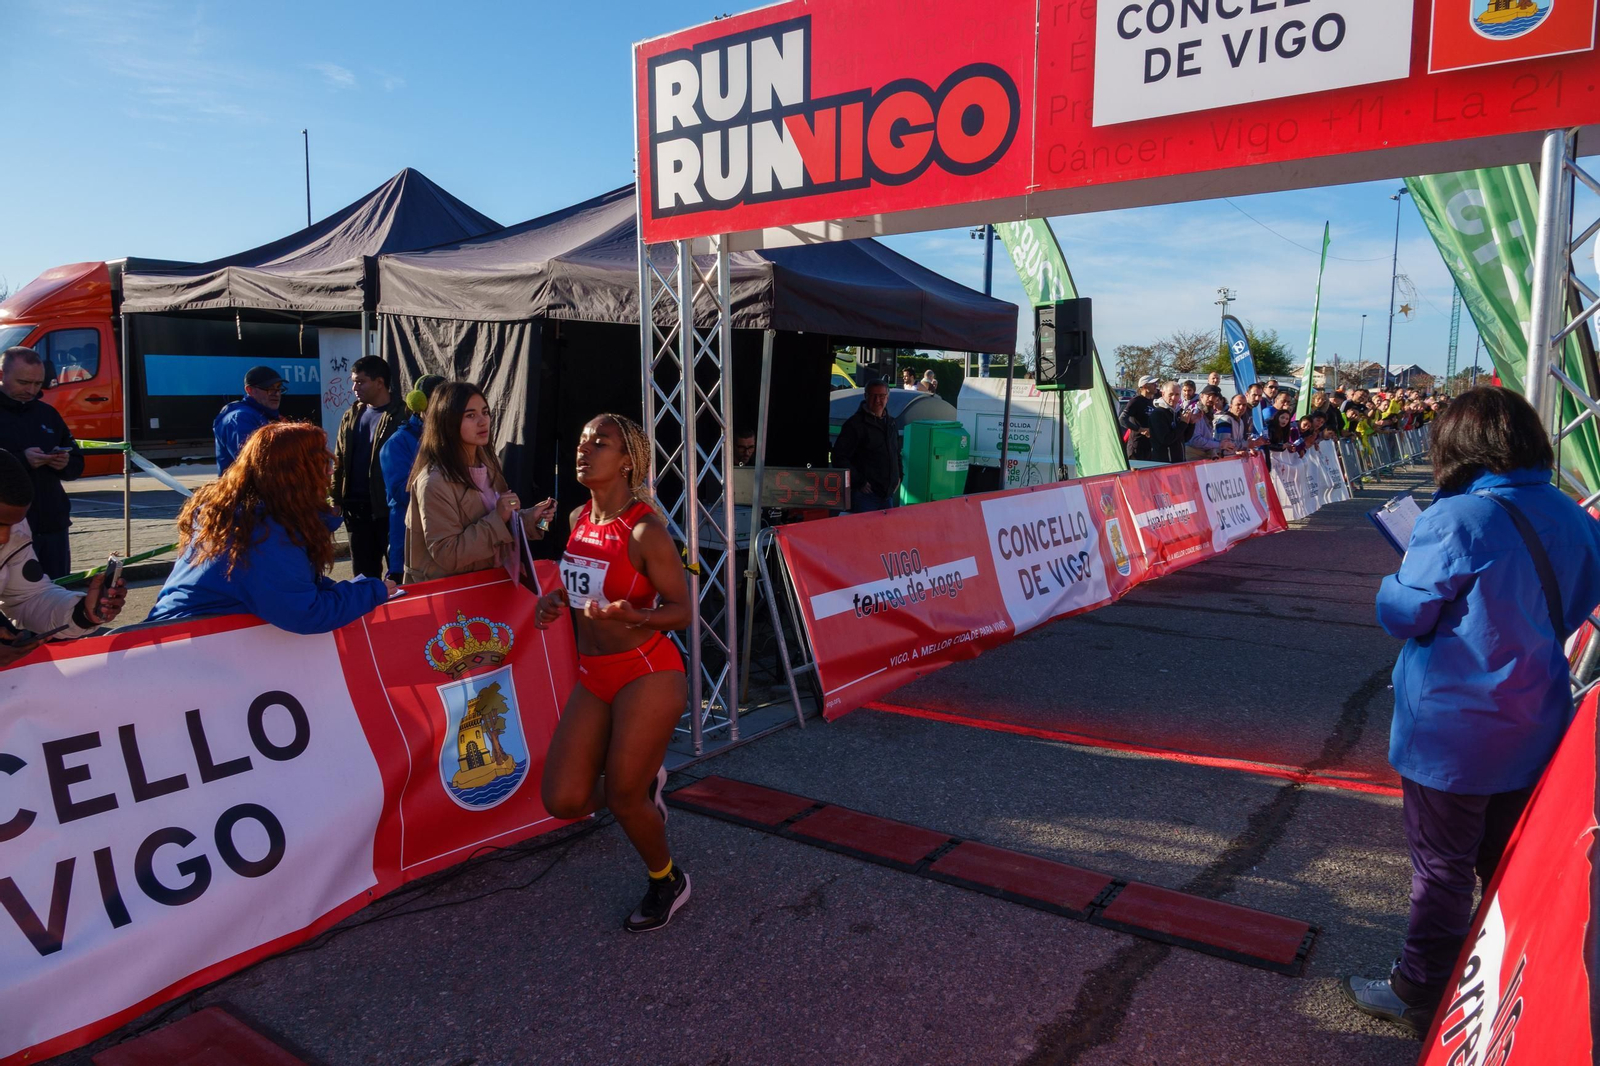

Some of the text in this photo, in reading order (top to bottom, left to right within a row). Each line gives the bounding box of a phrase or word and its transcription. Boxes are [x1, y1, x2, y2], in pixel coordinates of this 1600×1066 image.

[1144, 12, 1346, 84] DE VIGO
[655, 28, 804, 133] RUN
[1046, 69, 1563, 174] Cáncer Vigo +11 La 21
[280, 365, 320, 383] TRA
[998, 421, 1031, 429] ROLLIDA
[998, 433, 1030, 441] UADOS
[1205, 477, 1246, 503] CONCELLO
[1216, 503, 1251, 531] DE VIGO
[998, 511, 1088, 560] CONCELLO
[563, 568, 590, 595] 113
[880, 548, 929, 581] VIGO,
[1018, 551, 1091, 600] DE VIGO
[853, 570, 963, 619] terreo de xogo
[912, 648, 919, 660] A
[921, 638, 953, 657] MELLOR
[953, 629, 979, 645] CIDADE
[979, 625, 994, 638] PARA
[0, 803, 286, 957] VIGO
